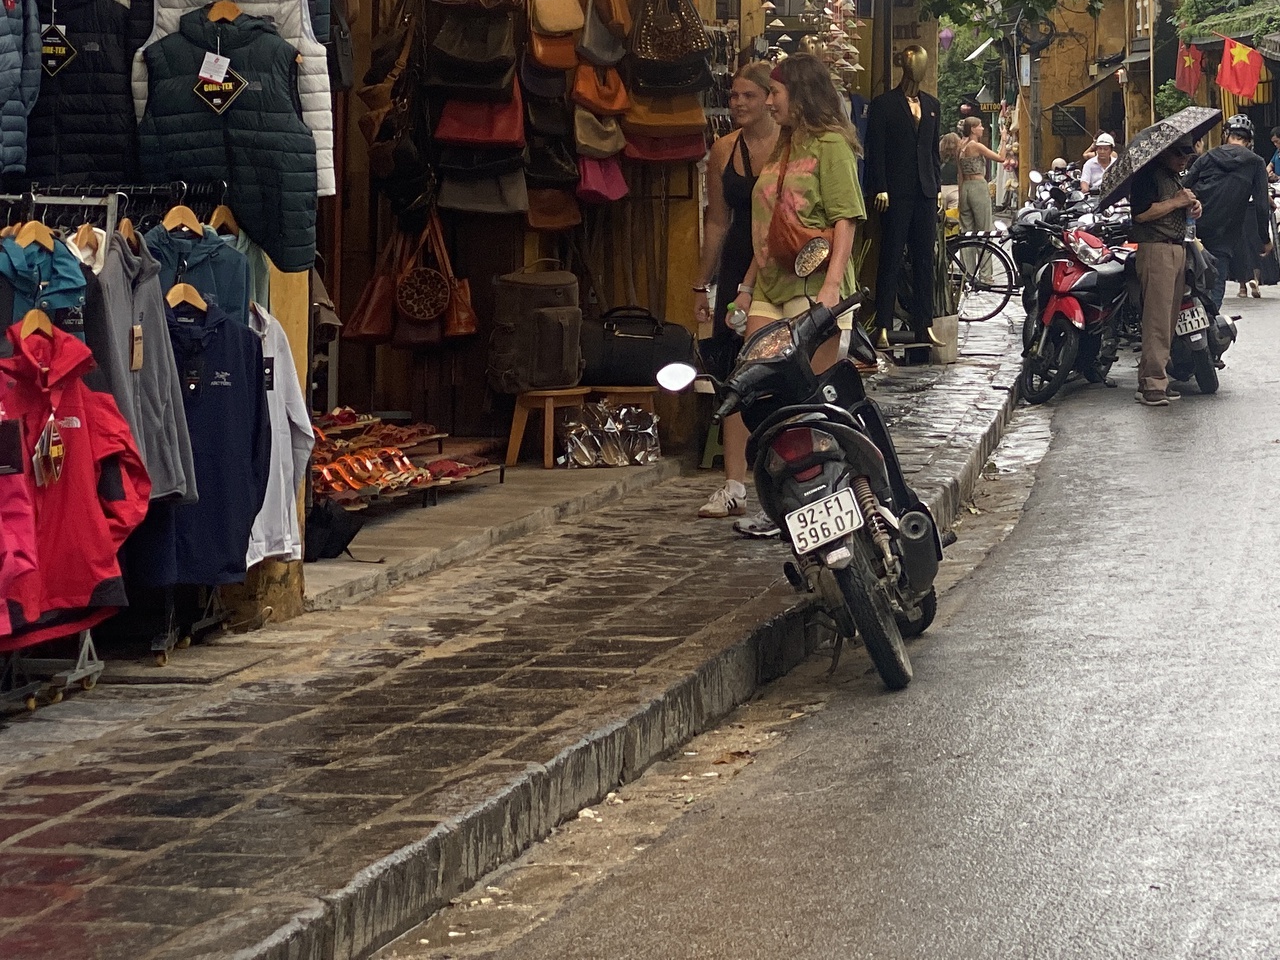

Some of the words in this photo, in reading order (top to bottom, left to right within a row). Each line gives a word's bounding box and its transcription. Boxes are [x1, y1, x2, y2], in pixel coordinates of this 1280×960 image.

[980, 103, 1000, 111] TATTOO
[1178, 317, 1206, 333] 171.71
[804, 484, 827, 496] HONDA
[796, 496, 843, 529] 92-F1
[796, 509, 854, 549] 596.07
